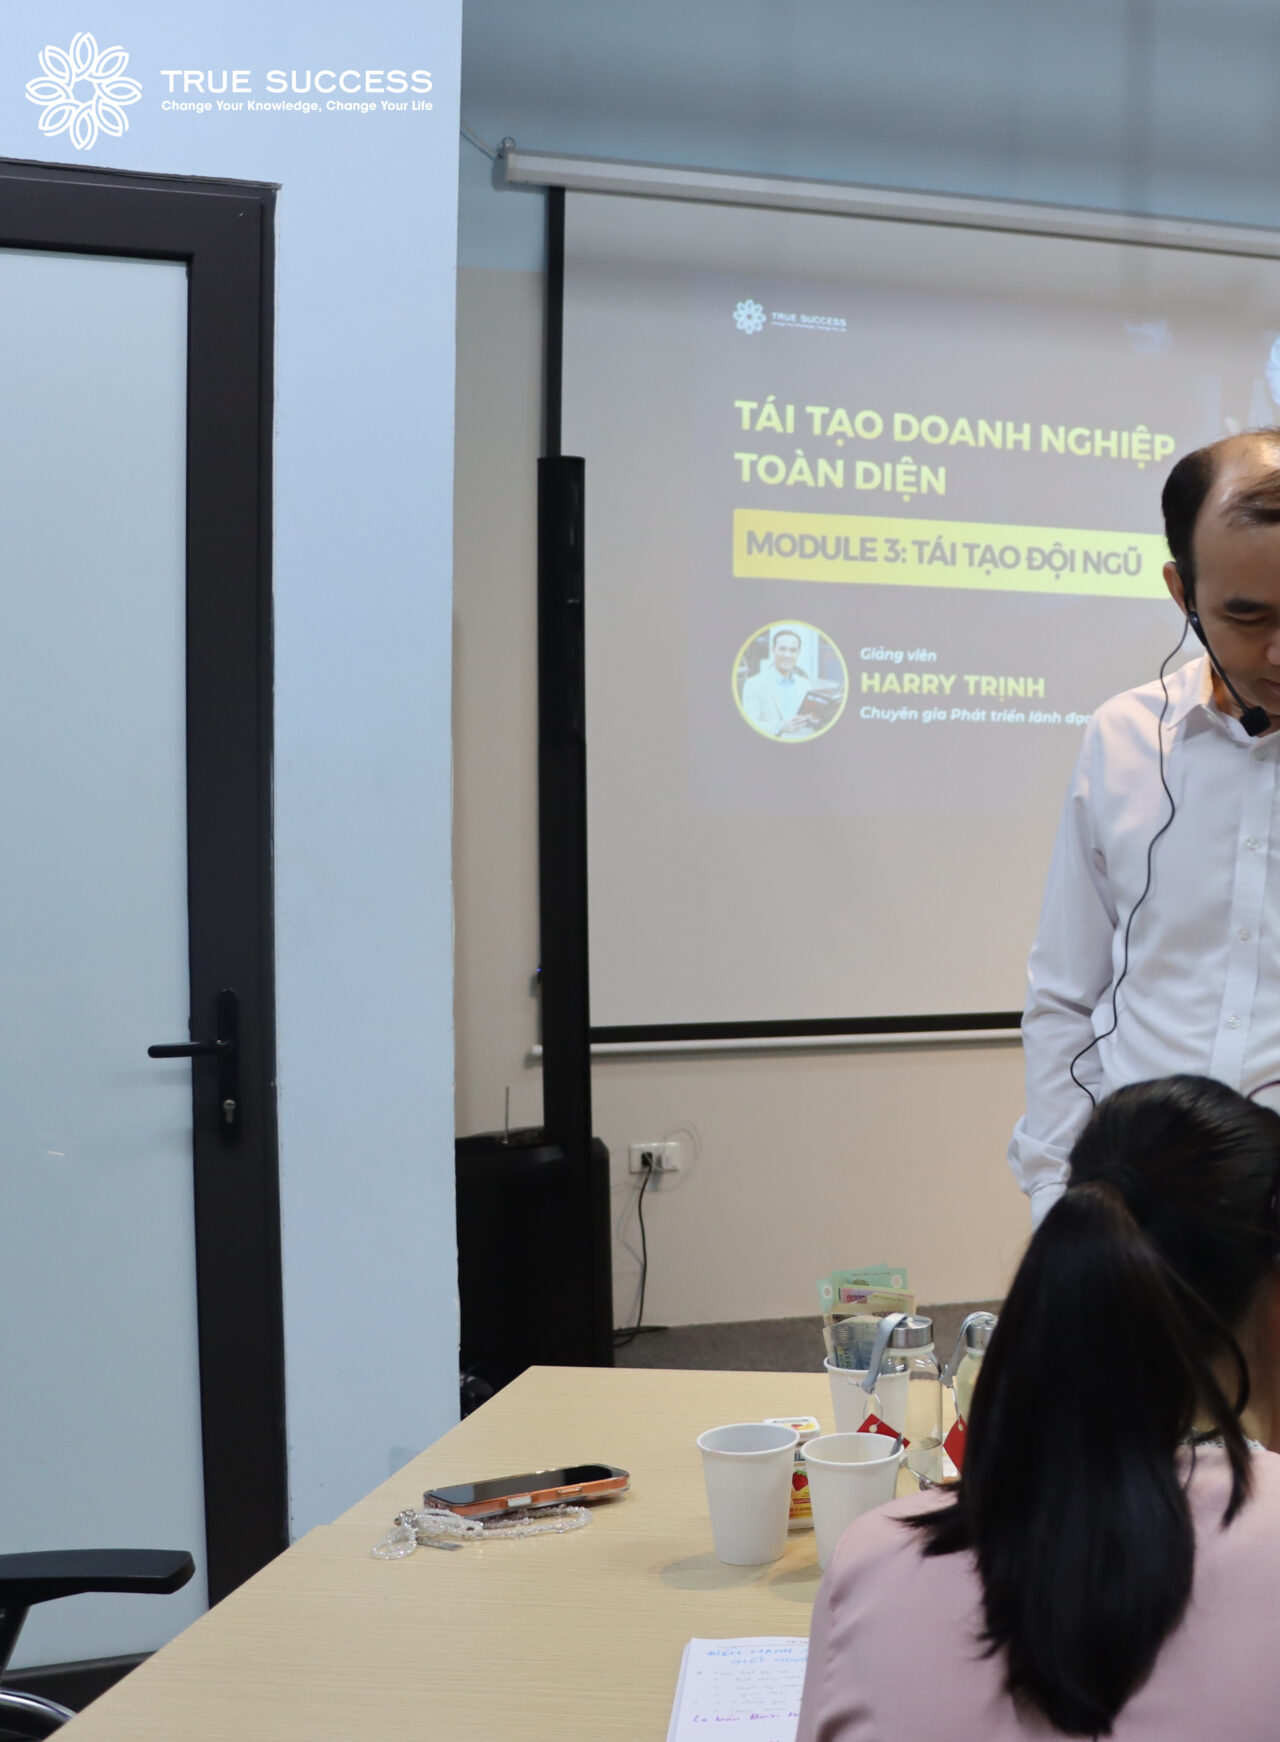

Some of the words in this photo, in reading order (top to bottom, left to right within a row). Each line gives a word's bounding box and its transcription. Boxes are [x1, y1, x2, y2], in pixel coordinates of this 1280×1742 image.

[771, 311, 797, 322] TRUE
[800, 314, 847, 327] SUCCESS
[733, 395, 795, 433] TÁI
[805, 403, 884, 447] TẠO
[893, 412, 1031, 452] DOANH
[1040, 424, 1176, 469] NGHIỆP
[733, 448, 844, 490] TOÀN
[855, 456, 947, 503] DIỆN
[746, 530, 879, 563] MODULE
[883, 537, 907, 564] 3:
[911, 535, 957, 567] TÁI
[962, 542, 1021, 576] TẠO
[1026, 541, 1076, 580] ĐỘI
[1082, 546, 1143, 577] NGŨ
[861, 671, 957, 695] HARRY
[963, 674, 1046, 702] TRỊNH
[859, 705, 919, 724] Chuyên
[921, 706, 948, 724] gia
[950, 708, 988, 722] Phát
